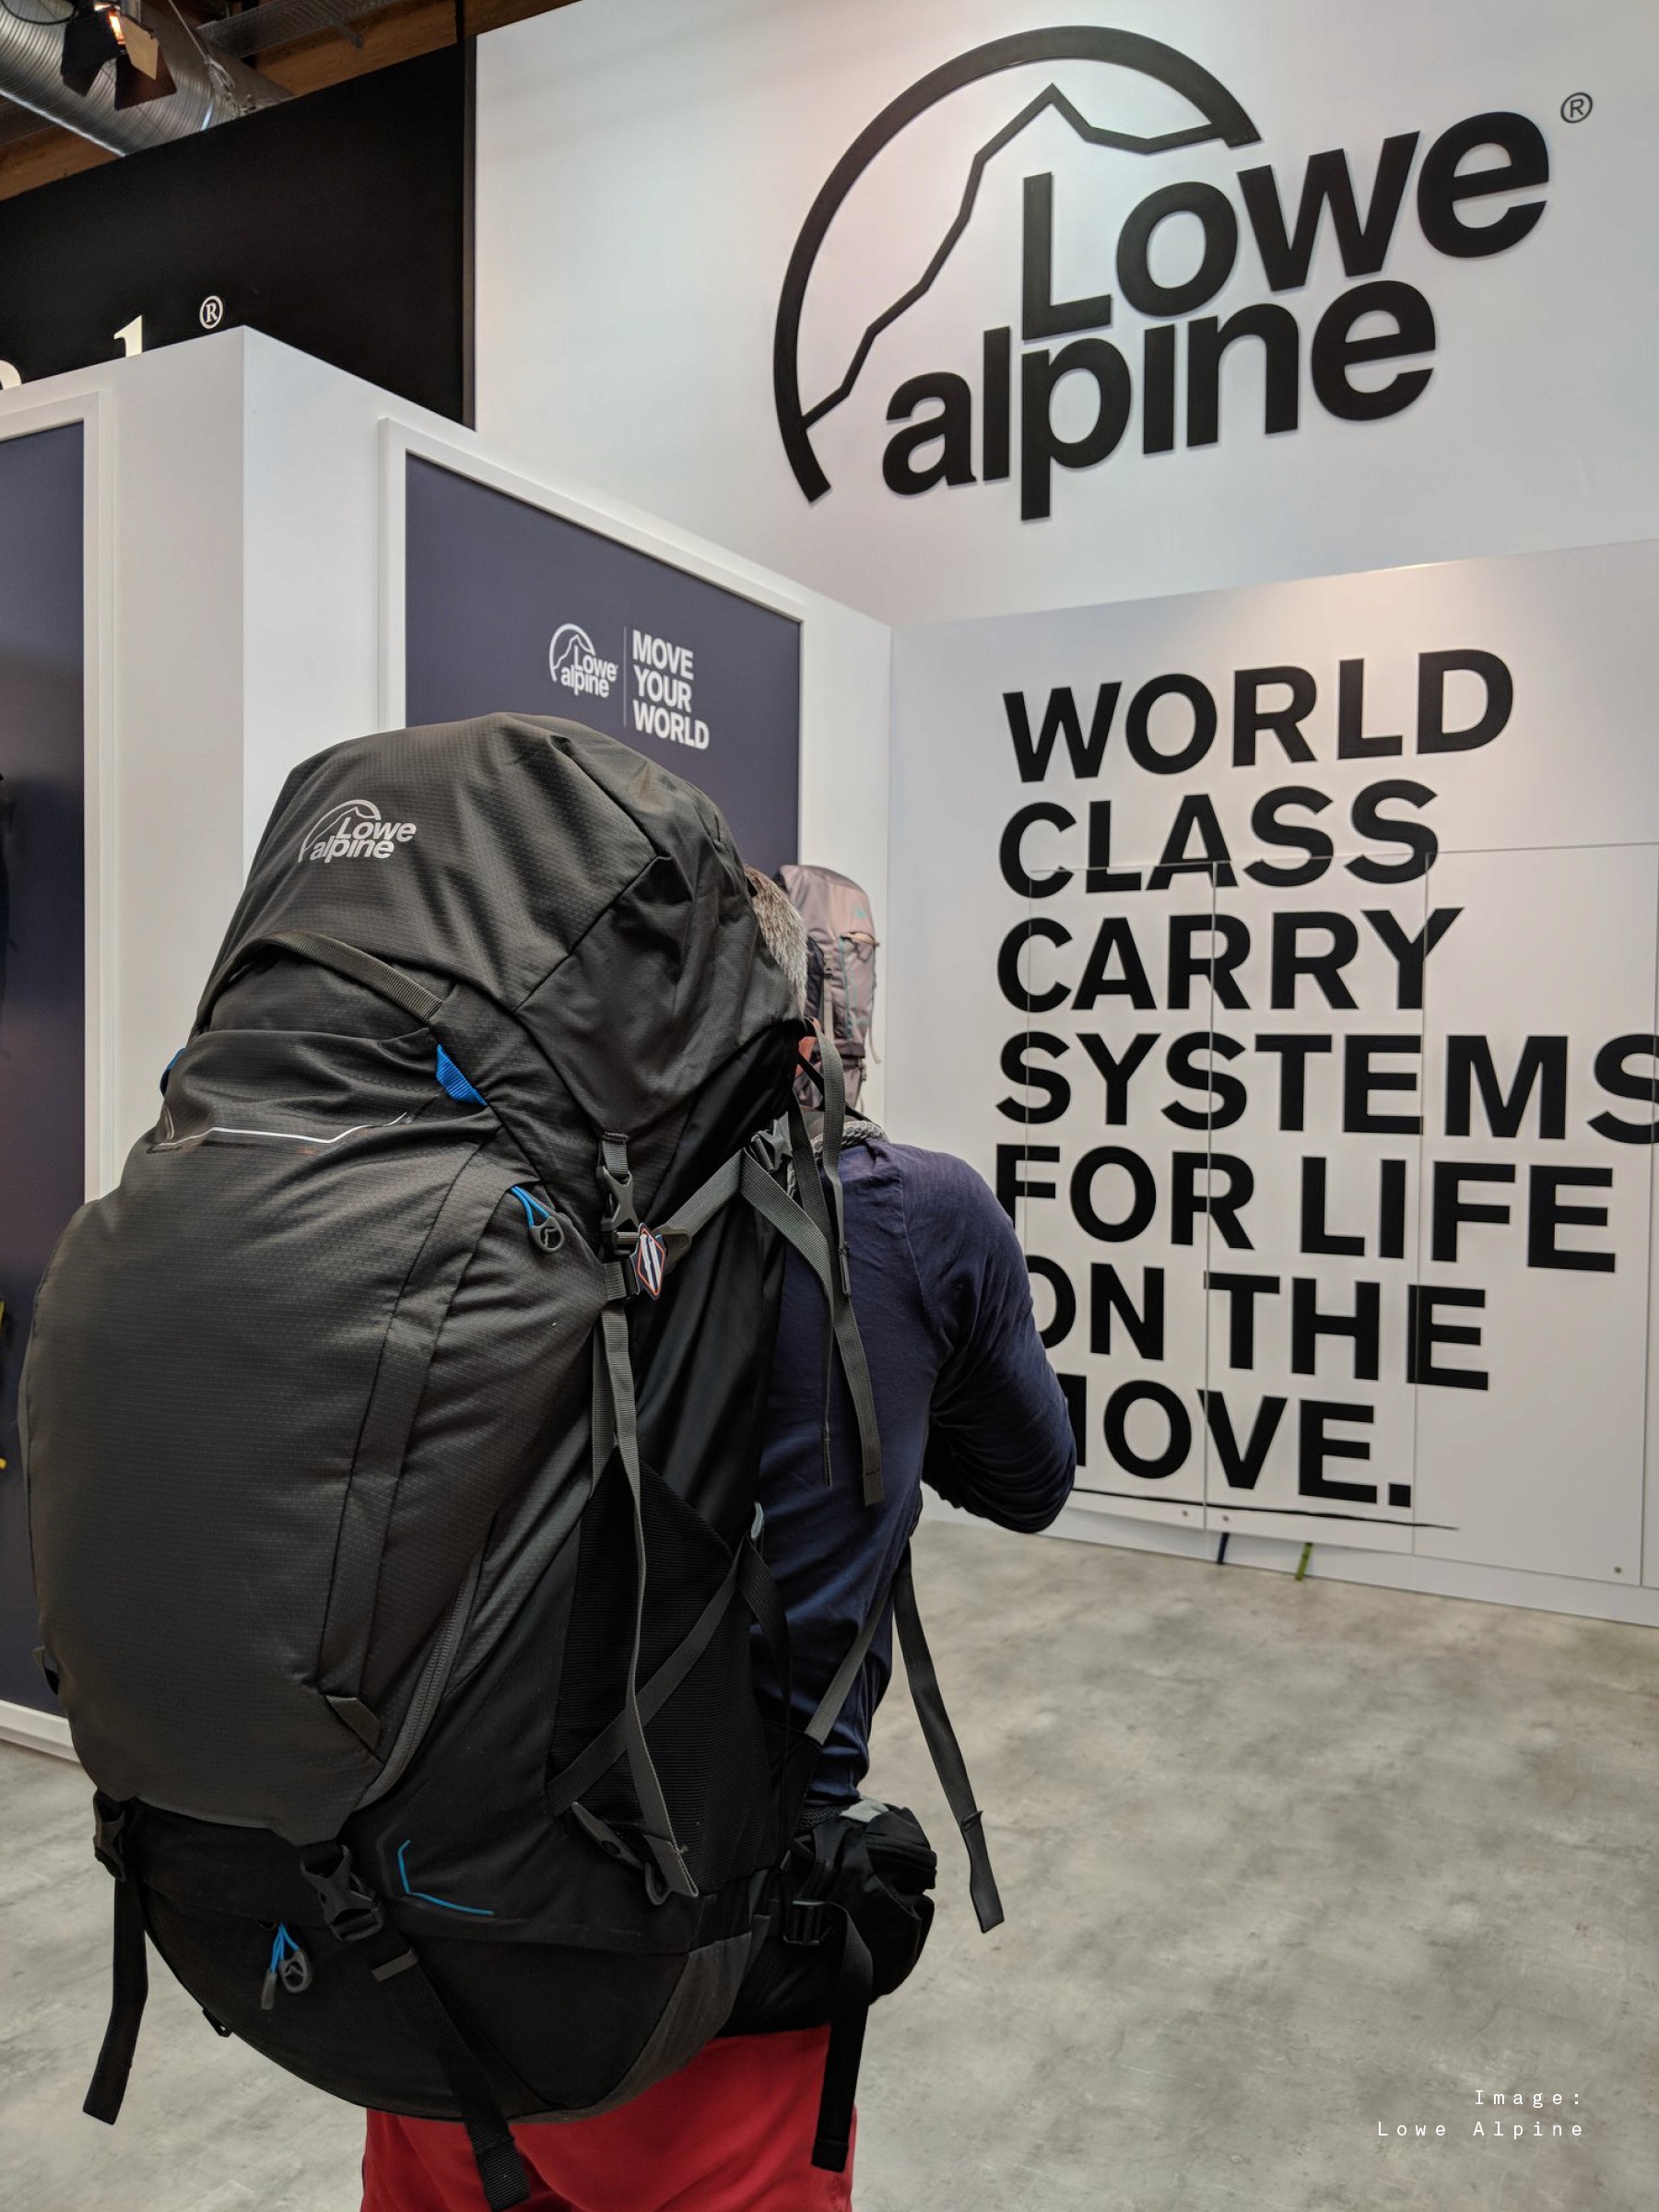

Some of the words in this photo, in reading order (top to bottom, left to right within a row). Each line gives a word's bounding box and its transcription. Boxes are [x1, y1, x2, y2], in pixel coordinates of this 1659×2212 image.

[1021, 111, 1550, 342] Lowe
[882, 279, 1436, 522] alpine
[560, 664, 610, 698] alpine
[573, 644, 618, 682] Lowe
[632, 629, 694, 680] MOVE
[633, 664, 692, 713] YOUR
[632, 699, 710, 750] WORLD
[1002, 649, 1513, 783] WORLD
[309, 835, 395, 864] alpine
[335, 817, 418, 842] Lowe
[999, 779, 1439, 900] CLASS
[997, 907, 1464, 1014] CARRY
[995, 1030, 1659, 1145] SYSTEMS
[995, 1143, 1254, 1251] FOR
[1300, 1156, 1616, 1274] LIFE
[1204, 1270, 1489, 1391] THE
[1056, 1372, 1412, 1509] OVE.
